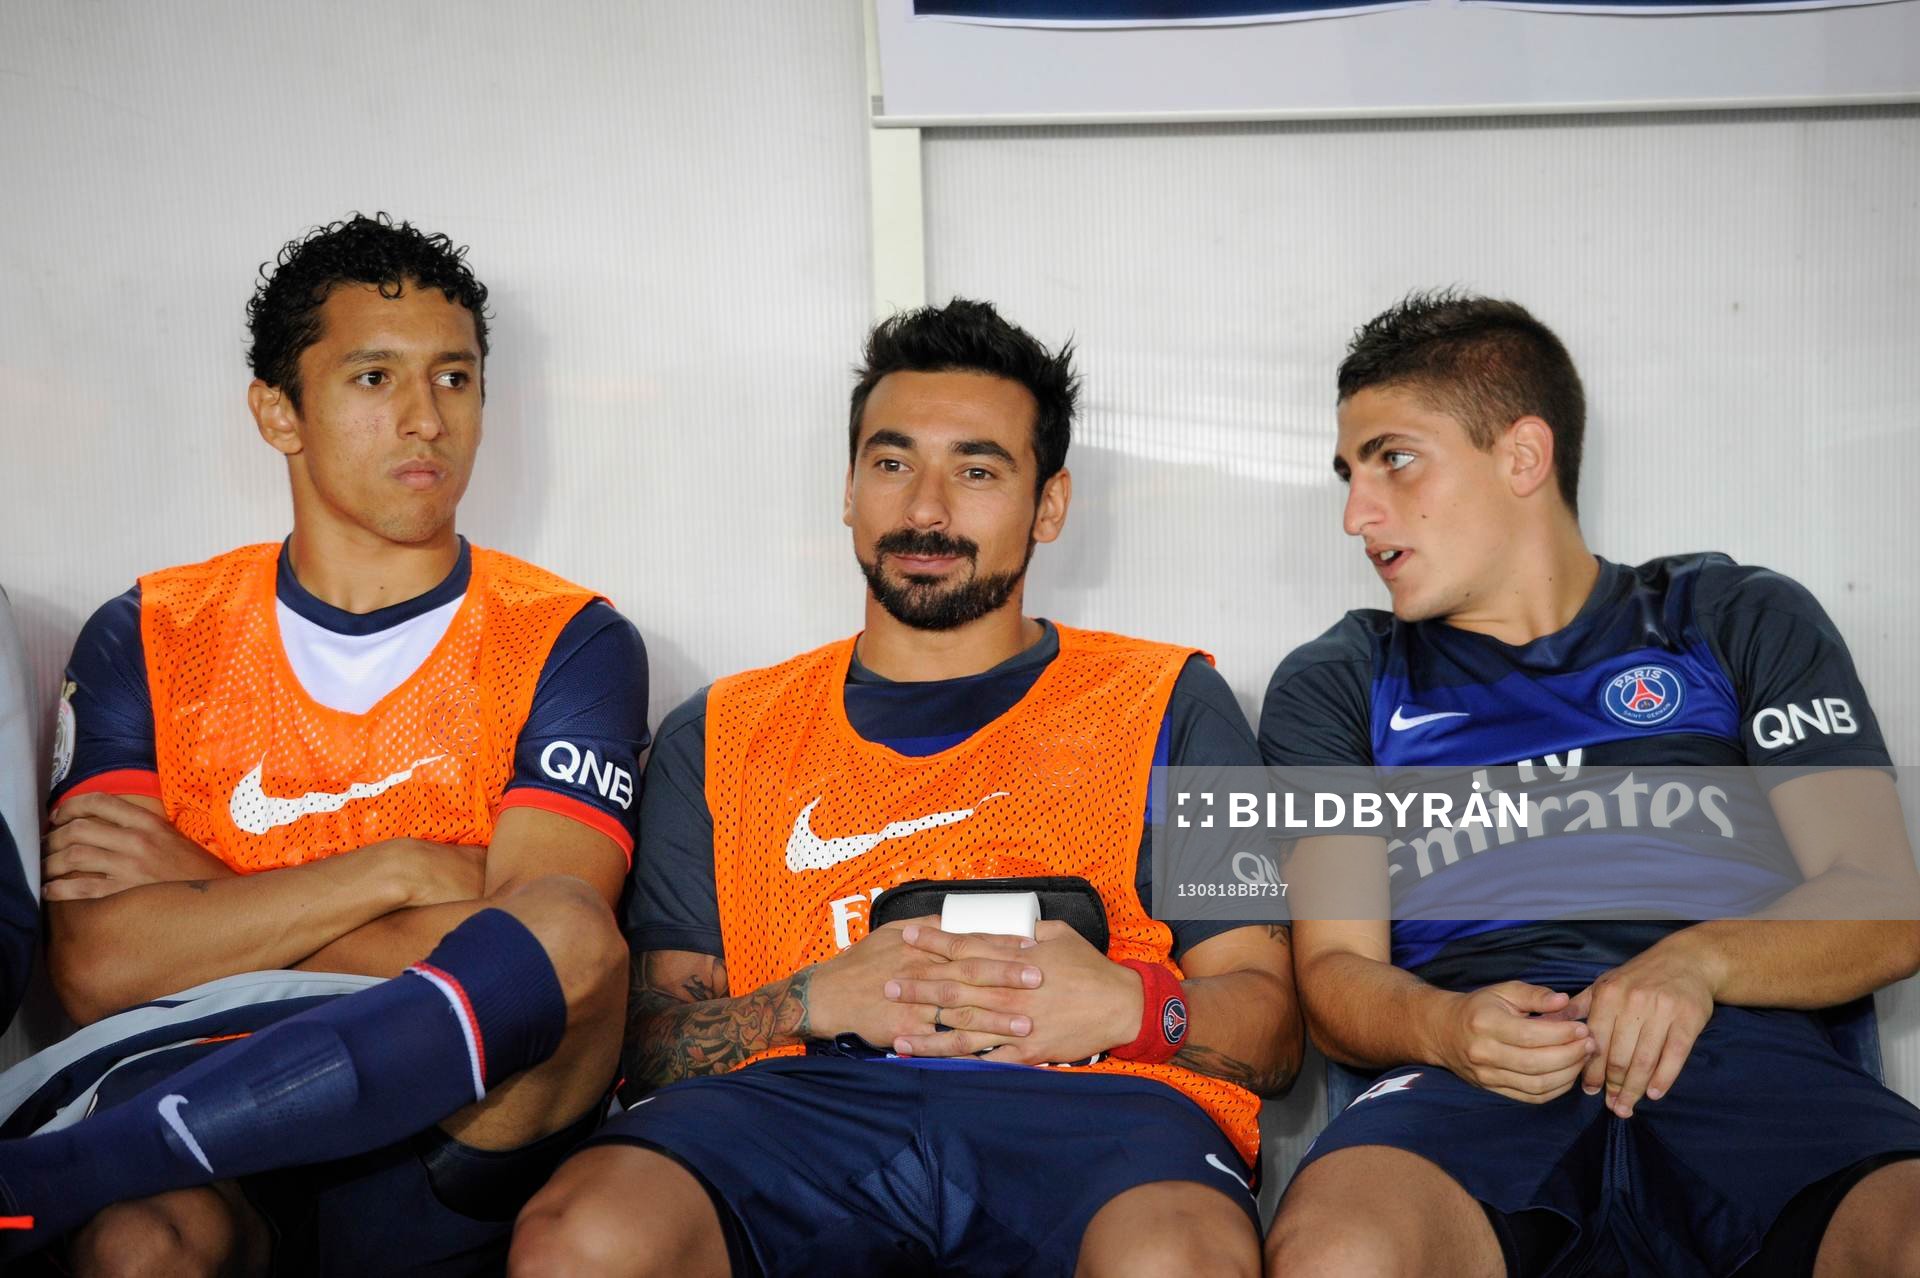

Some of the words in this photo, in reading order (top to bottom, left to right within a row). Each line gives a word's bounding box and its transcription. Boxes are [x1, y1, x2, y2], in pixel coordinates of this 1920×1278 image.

[1614, 669, 1662, 688] PARIS
[1752, 697, 1858, 749] QNB
[540, 740, 634, 810] QNB
